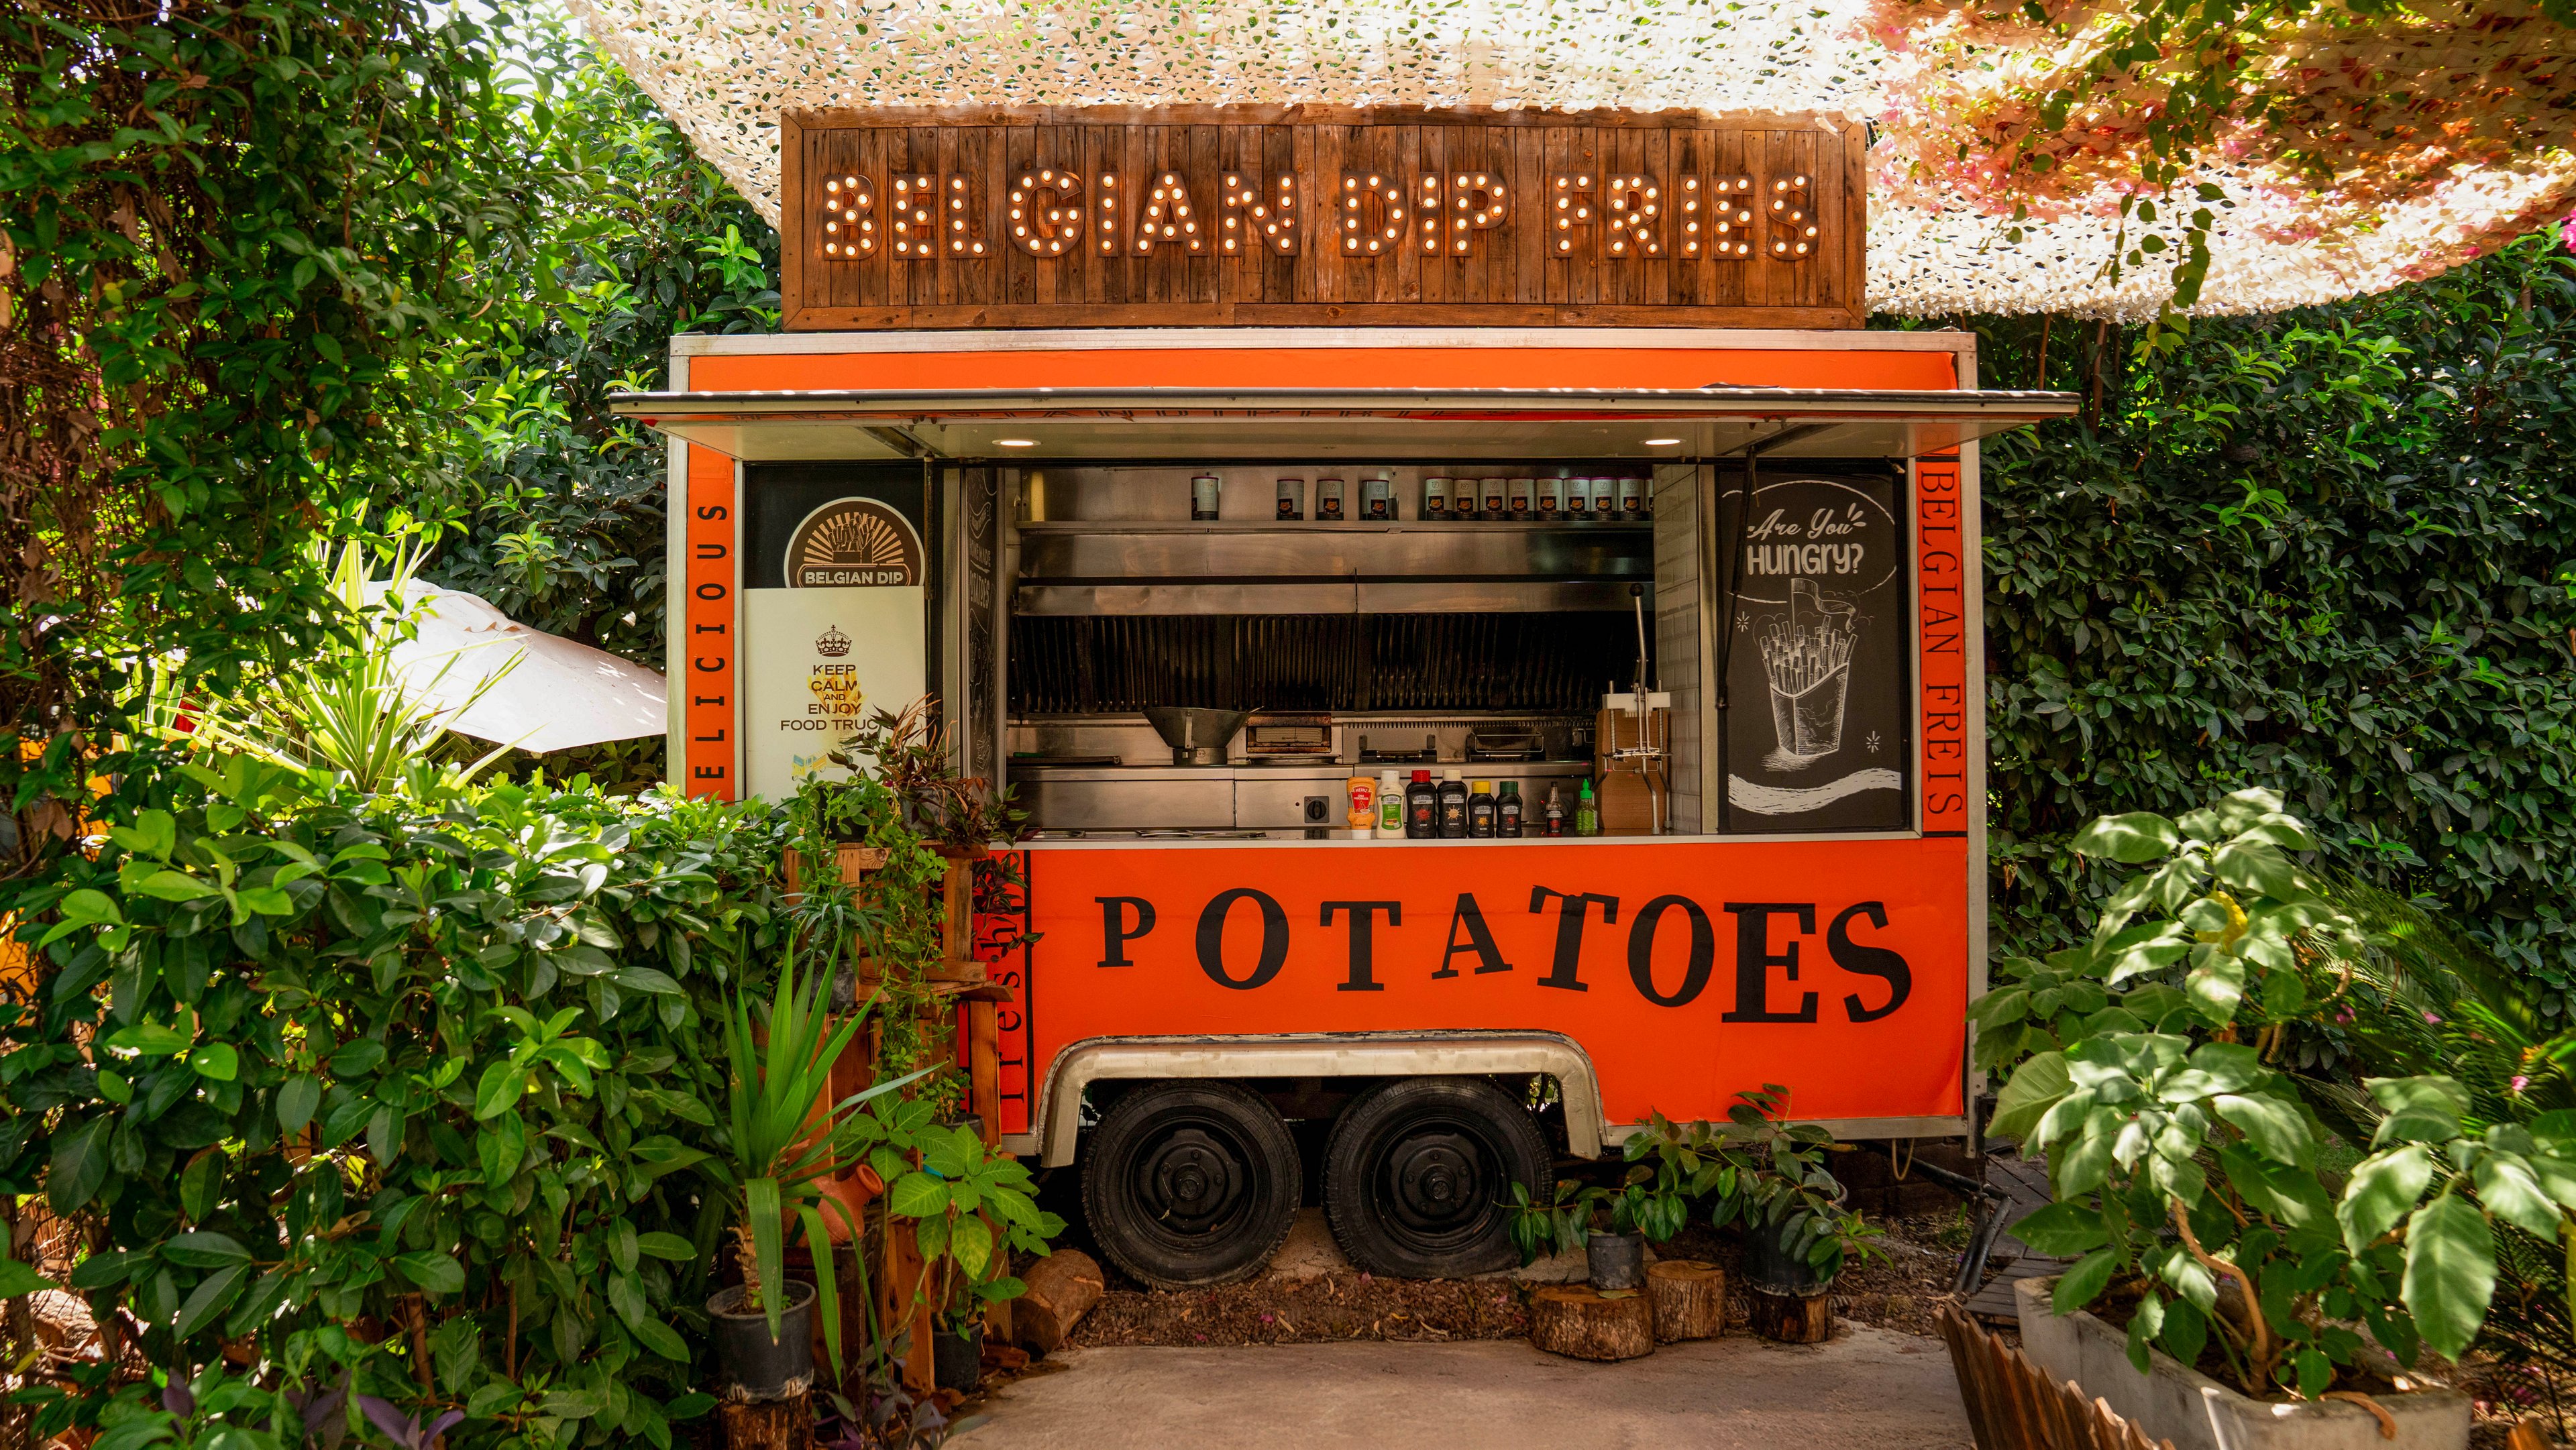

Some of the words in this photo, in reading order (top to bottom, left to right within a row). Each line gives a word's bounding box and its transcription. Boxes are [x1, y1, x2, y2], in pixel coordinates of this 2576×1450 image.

[823, 167, 1300, 260] BELGIAN
[1340, 171, 1510, 257] DIP
[1552, 172, 1819, 261] FRIES
[1747, 508, 1801, 541] Are
[1808, 508, 1853, 538] You
[805, 571, 873, 585] BELGIAN
[877, 571, 904, 585] DIP
[1920, 469, 1960, 656] BELGIAN
[694, 504, 728, 779] ELICIOUS
[811, 680, 857, 691] CALM
[813, 664, 857, 675] KEEP
[780, 720, 827, 731] FOOD
[831, 719, 879, 730] TRUC
[808, 703, 862, 714] ENJOY
[1925, 683, 1964, 816] FREIS
[1093, 885, 1913, 1023] POTATOES
